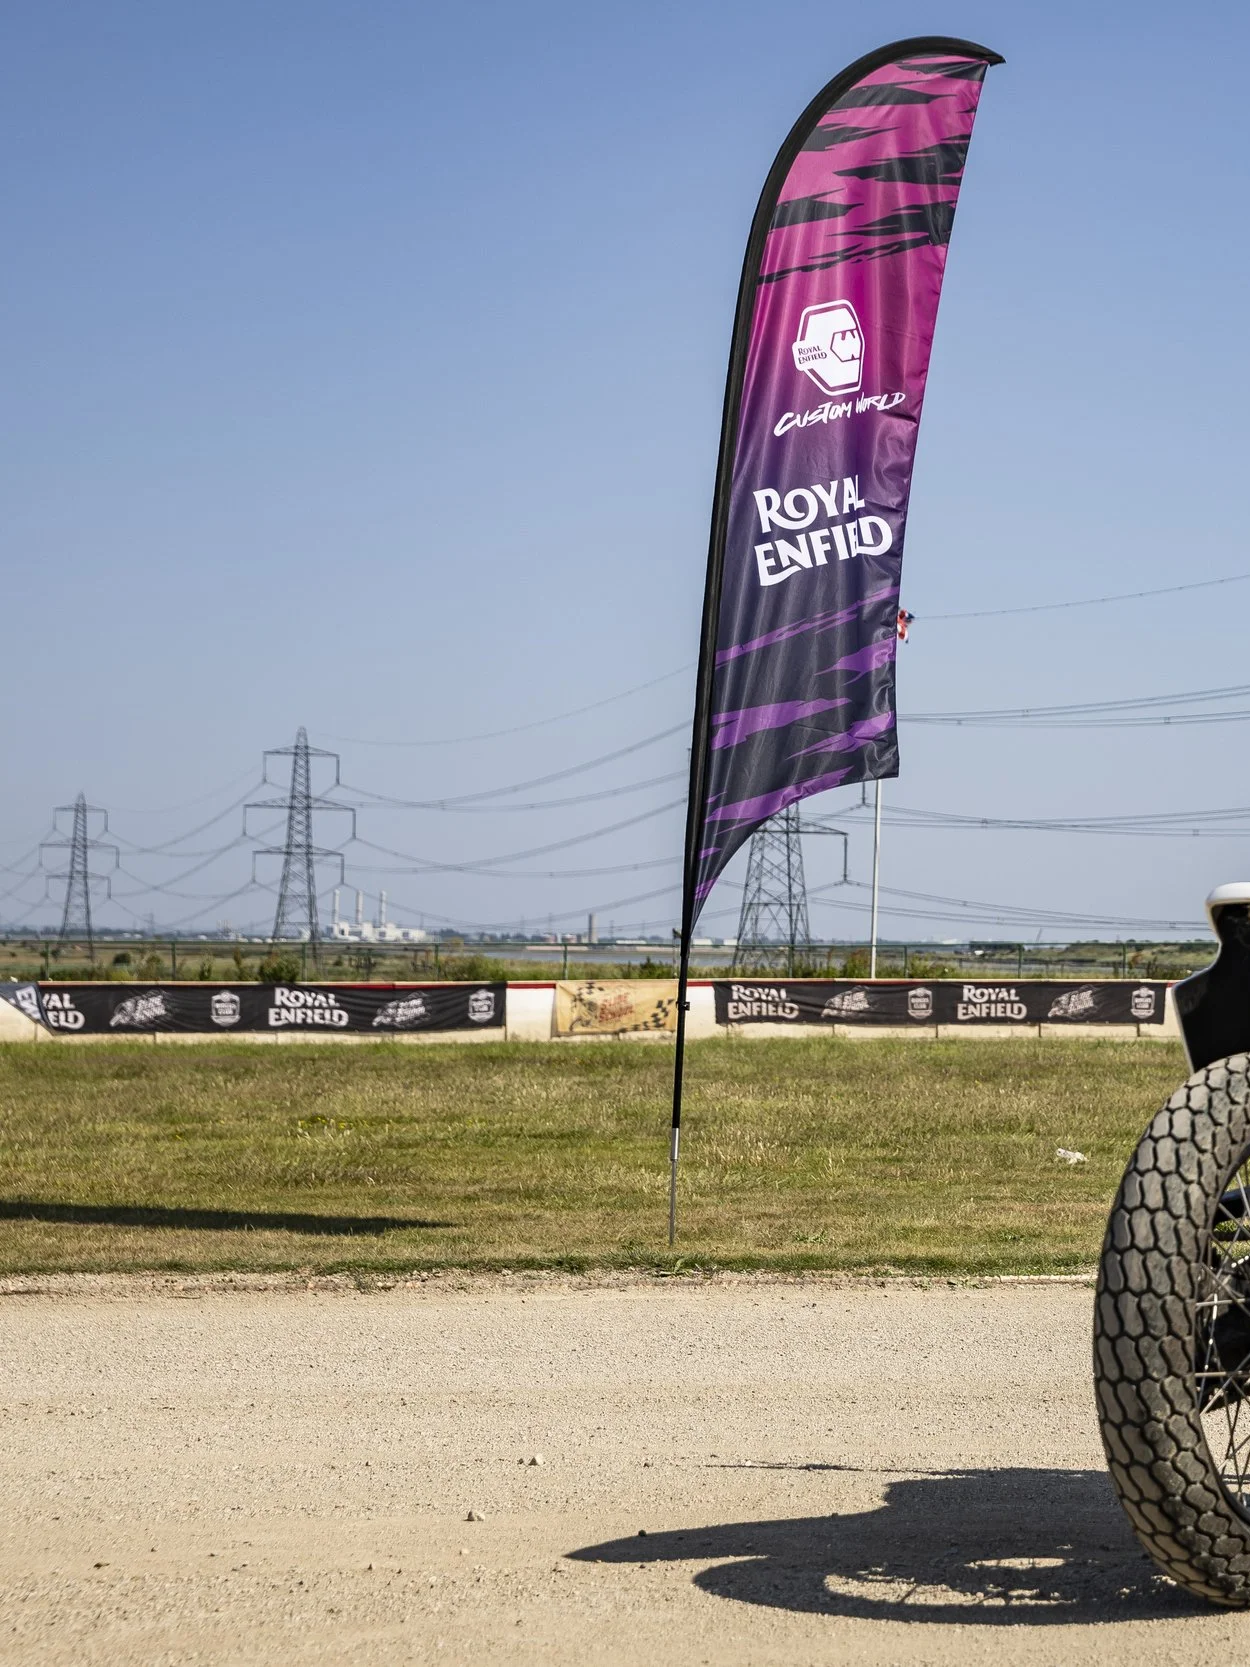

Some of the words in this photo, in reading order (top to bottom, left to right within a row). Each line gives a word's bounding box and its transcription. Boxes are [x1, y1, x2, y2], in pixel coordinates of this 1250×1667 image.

[798, 345, 822, 356] ROYAL
[798, 352, 828, 365] ENFIELD
[773, 401, 853, 437] CUSTOM
[753, 474, 866, 534] ROYAL
[274, 987, 341, 1008] ROYAL
[731, 984, 791, 1001] ROYAL
[962, 984, 1020, 1003] ROYAL
[268, 1007, 349, 1027] ENFIELD
[727, 1001, 800, 1019] ENFIELD
[957, 1002, 1027, 1020] ENFIELD
